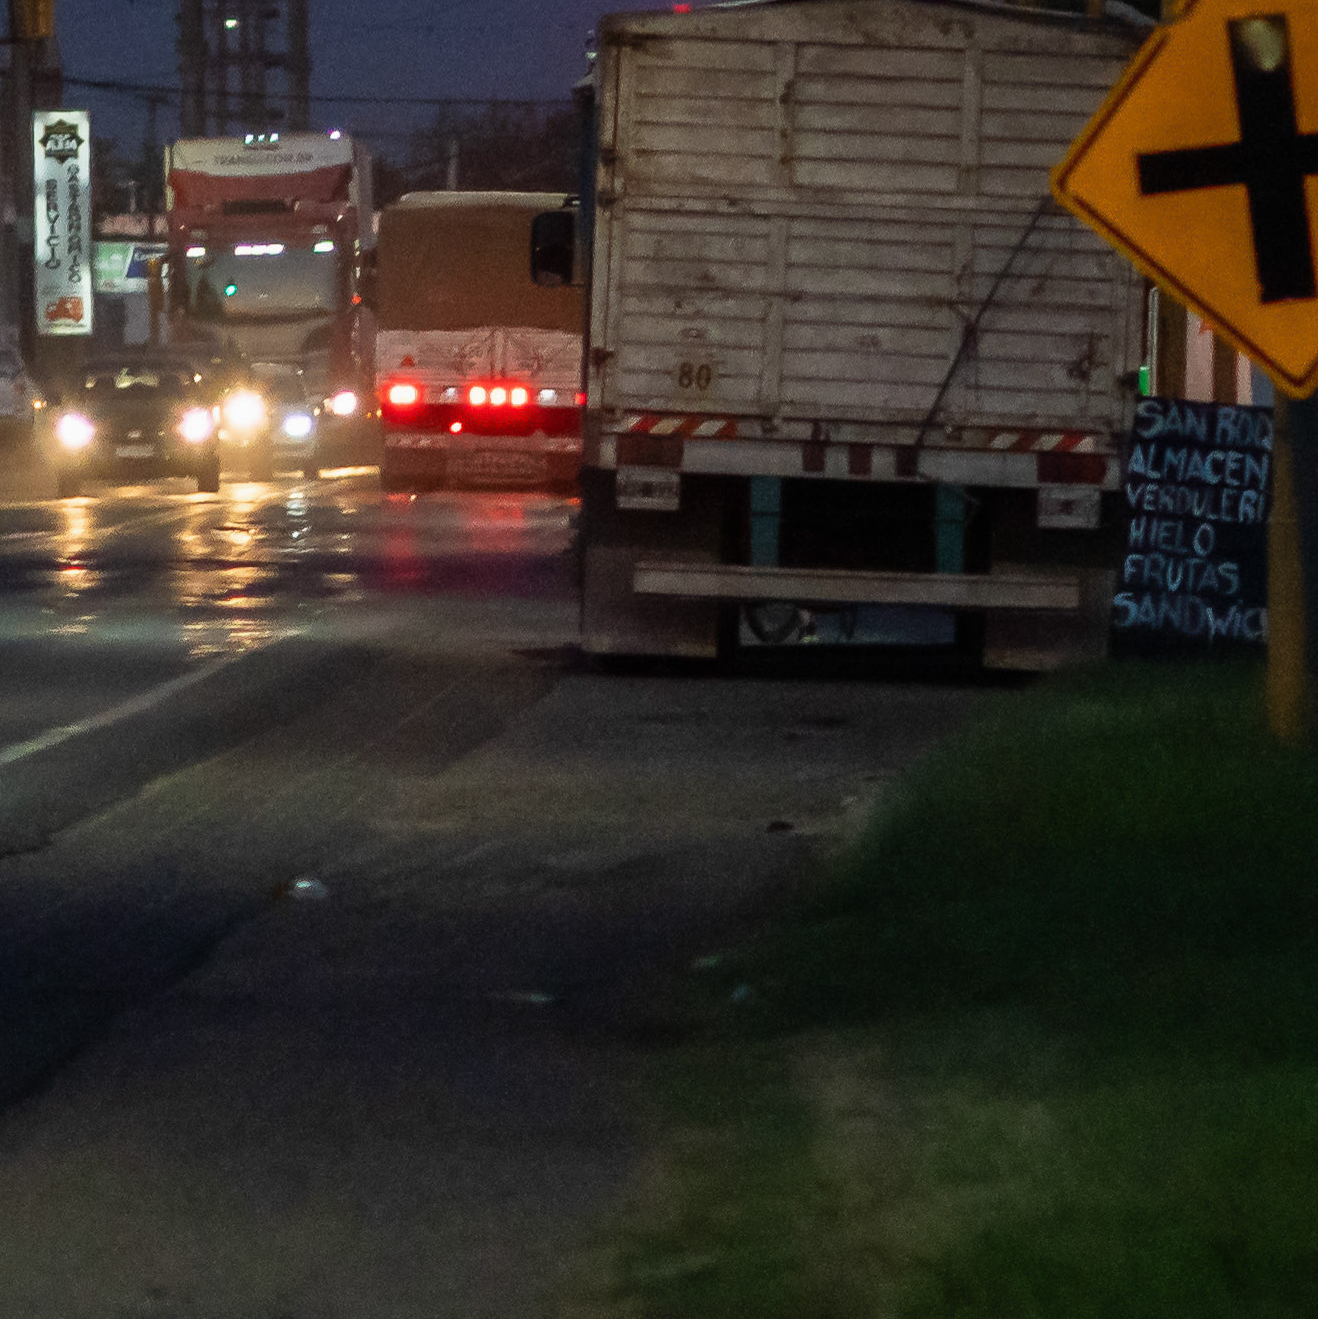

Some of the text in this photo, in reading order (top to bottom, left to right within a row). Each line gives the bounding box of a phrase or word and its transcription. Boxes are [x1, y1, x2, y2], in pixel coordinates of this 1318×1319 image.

[678, 361, 712, 391] 80
[1137, 400, 1274, 451] SAN ROQ
[1127, 443, 1269, 490] ALMACEN
[1127, 481, 1265, 524] VERDULERI
[1129, 516, 1216, 557] HIELO
[1123, 553, 1240, 594] FRUTAS
[1112, 591, 1269, 642] SANDWIC
